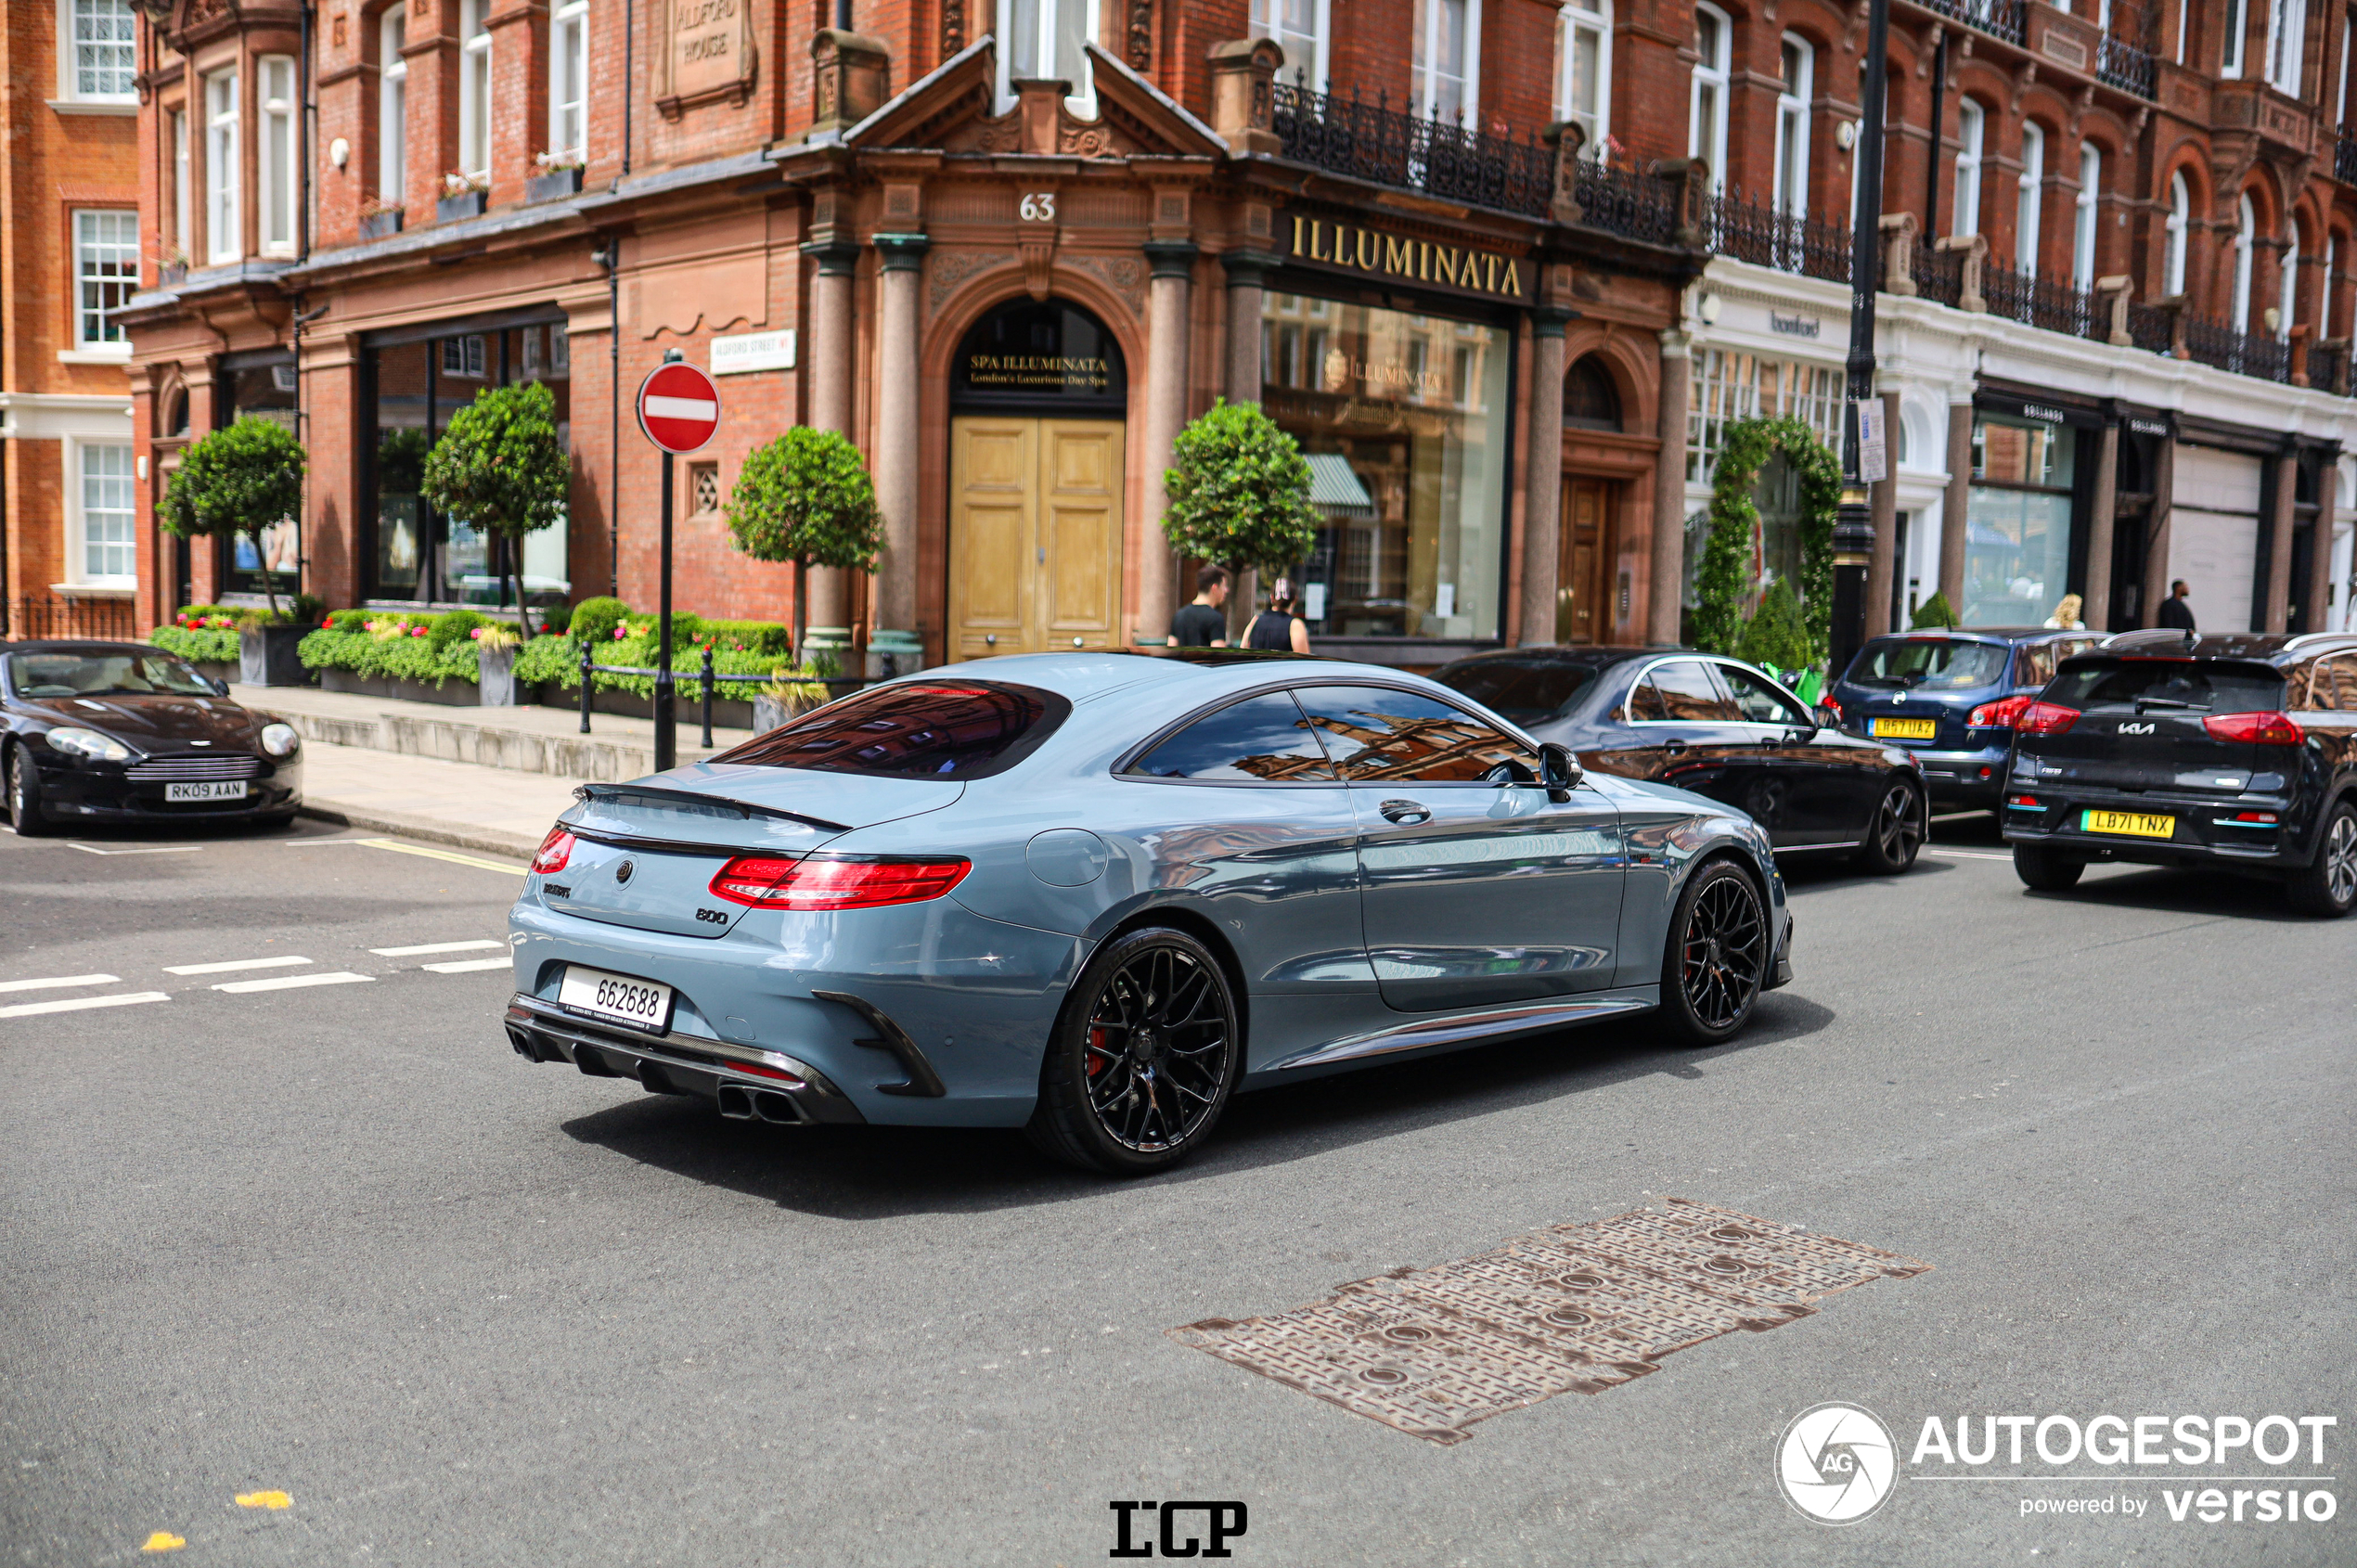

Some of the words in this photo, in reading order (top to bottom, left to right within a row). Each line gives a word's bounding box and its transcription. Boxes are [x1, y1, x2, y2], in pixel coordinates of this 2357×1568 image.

[684, 33, 727, 64] HOUSE
[1021, 193, 1055, 222] 63
[1291, 215, 1522, 297] ILLUMINATA
[750, 338, 776, 353] STREET
[971, 354, 999, 370] SPA
[1003, 355, 1109, 372] ILLUMINATA
[1349, 353, 1442, 390] ILLUMINATA
[971, 373, 1014, 384] London's
[1017, 374, 1066, 386] Luxurious
[1068, 375, 1087, 387] Day
[1088, 375, 1109, 388] Spa
[172, 784, 210, 798] RK09
[214, 782, 240, 796] AAN
[2096, 813, 2132, 829] LB71
[2138, 816, 2169, 833] TNX
[695, 907, 728, 925] 800
[597, 979, 660, 1017] 662688
[1378, 1374, 1453, 1400] vodafone
